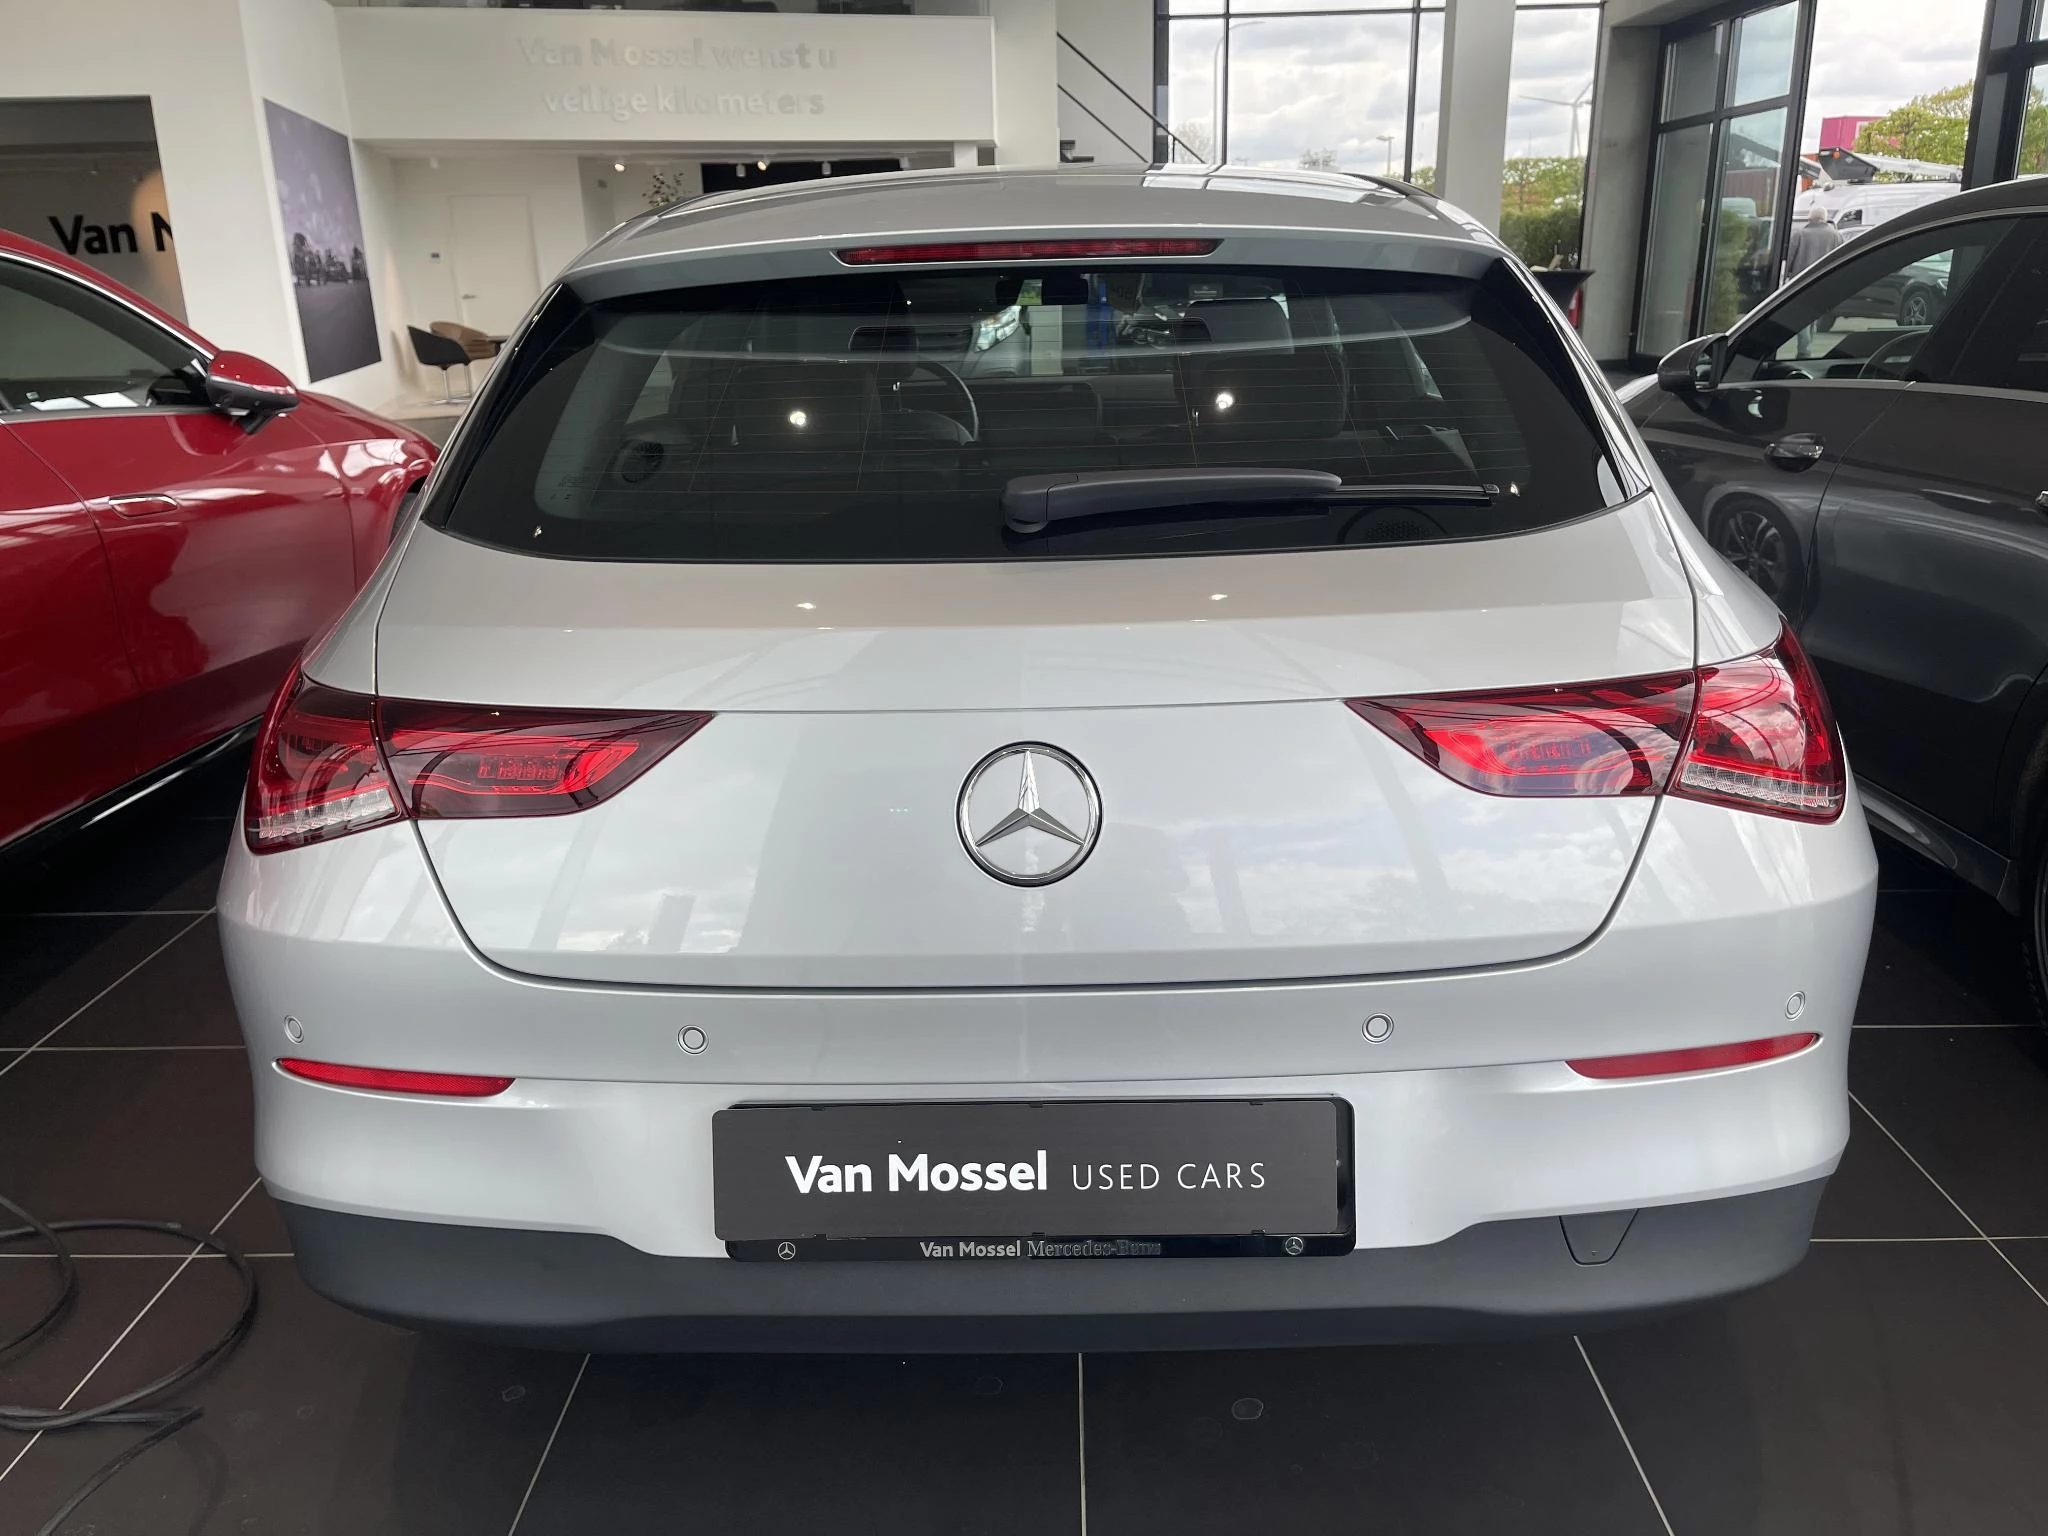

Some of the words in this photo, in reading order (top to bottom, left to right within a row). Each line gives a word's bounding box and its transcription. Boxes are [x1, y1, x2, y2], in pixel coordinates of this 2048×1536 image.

[515, 37, 582, 66] Van
[590, 37, 703, 68] Mossel
[711, 41, 811, 70] wenst
[818, 47, 838, 69] u
[542, 84, 649, 122] veilige
[655, 83, 826, 116] kilometers
[48, 215, 138, 255] Van
[784, 1155, 872, 1194] Van
[888, 1149, 1048, 1193] Mossel
[1071, 1163, 1160, 1191] USED
[1177, 1162, 1266, 1190] CARS
[919, 1241, 954, 1257] Van
[959, 1240, 1021, 1257] Mossel
[1027, 1239, 1162, 1257] Mercedes-Benz
